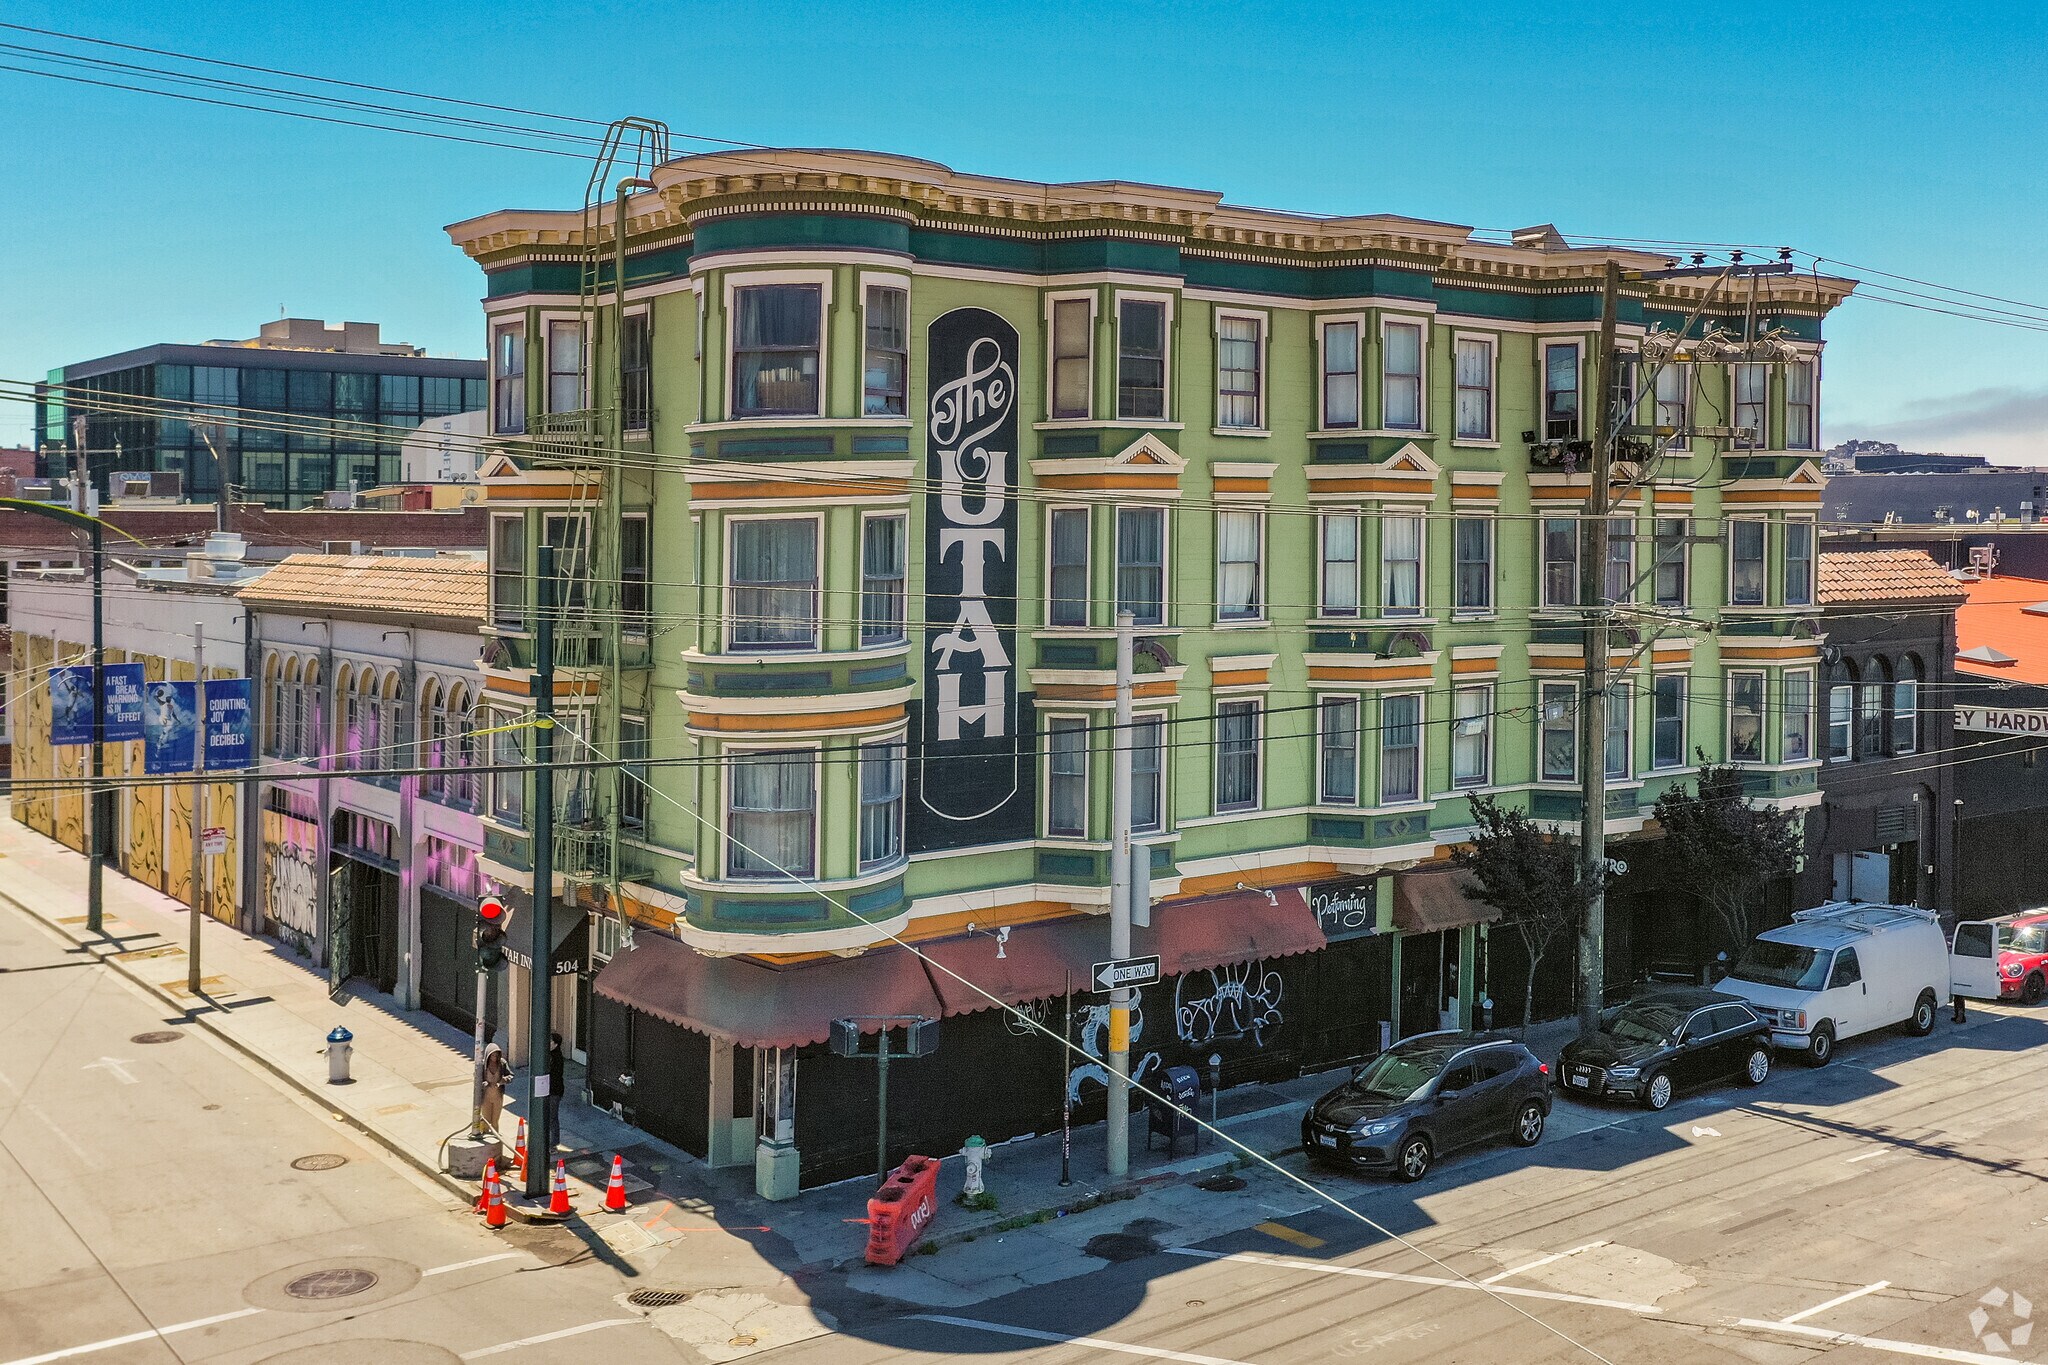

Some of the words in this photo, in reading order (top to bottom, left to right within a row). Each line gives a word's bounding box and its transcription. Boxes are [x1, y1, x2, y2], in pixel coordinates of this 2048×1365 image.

[931, 337, 1014, 446] The
[931, 450, 1011, 742] UTAH
[106, 676, 111, 686] A
[111, 675, 127, 686] FAST
[115, 684, 137, 695] BREAK
[107, 693, 138, 704] WARNING
[209, 698, 246, 711] COUNTING
[106, 703, 114, 714] IS
[114, 703, 122, 713] IN
[117, 712, 141, 722] EFFECT
[210, 711, 225, 723] JOY
[222, 722, 230, 734] IN
[210, 733, 245, 746] DECIBELS
[556, 960, 579, 974] 504
[1113, 968, 1131, 981] ONE
[1134, 964, 1153, 977] WAY
